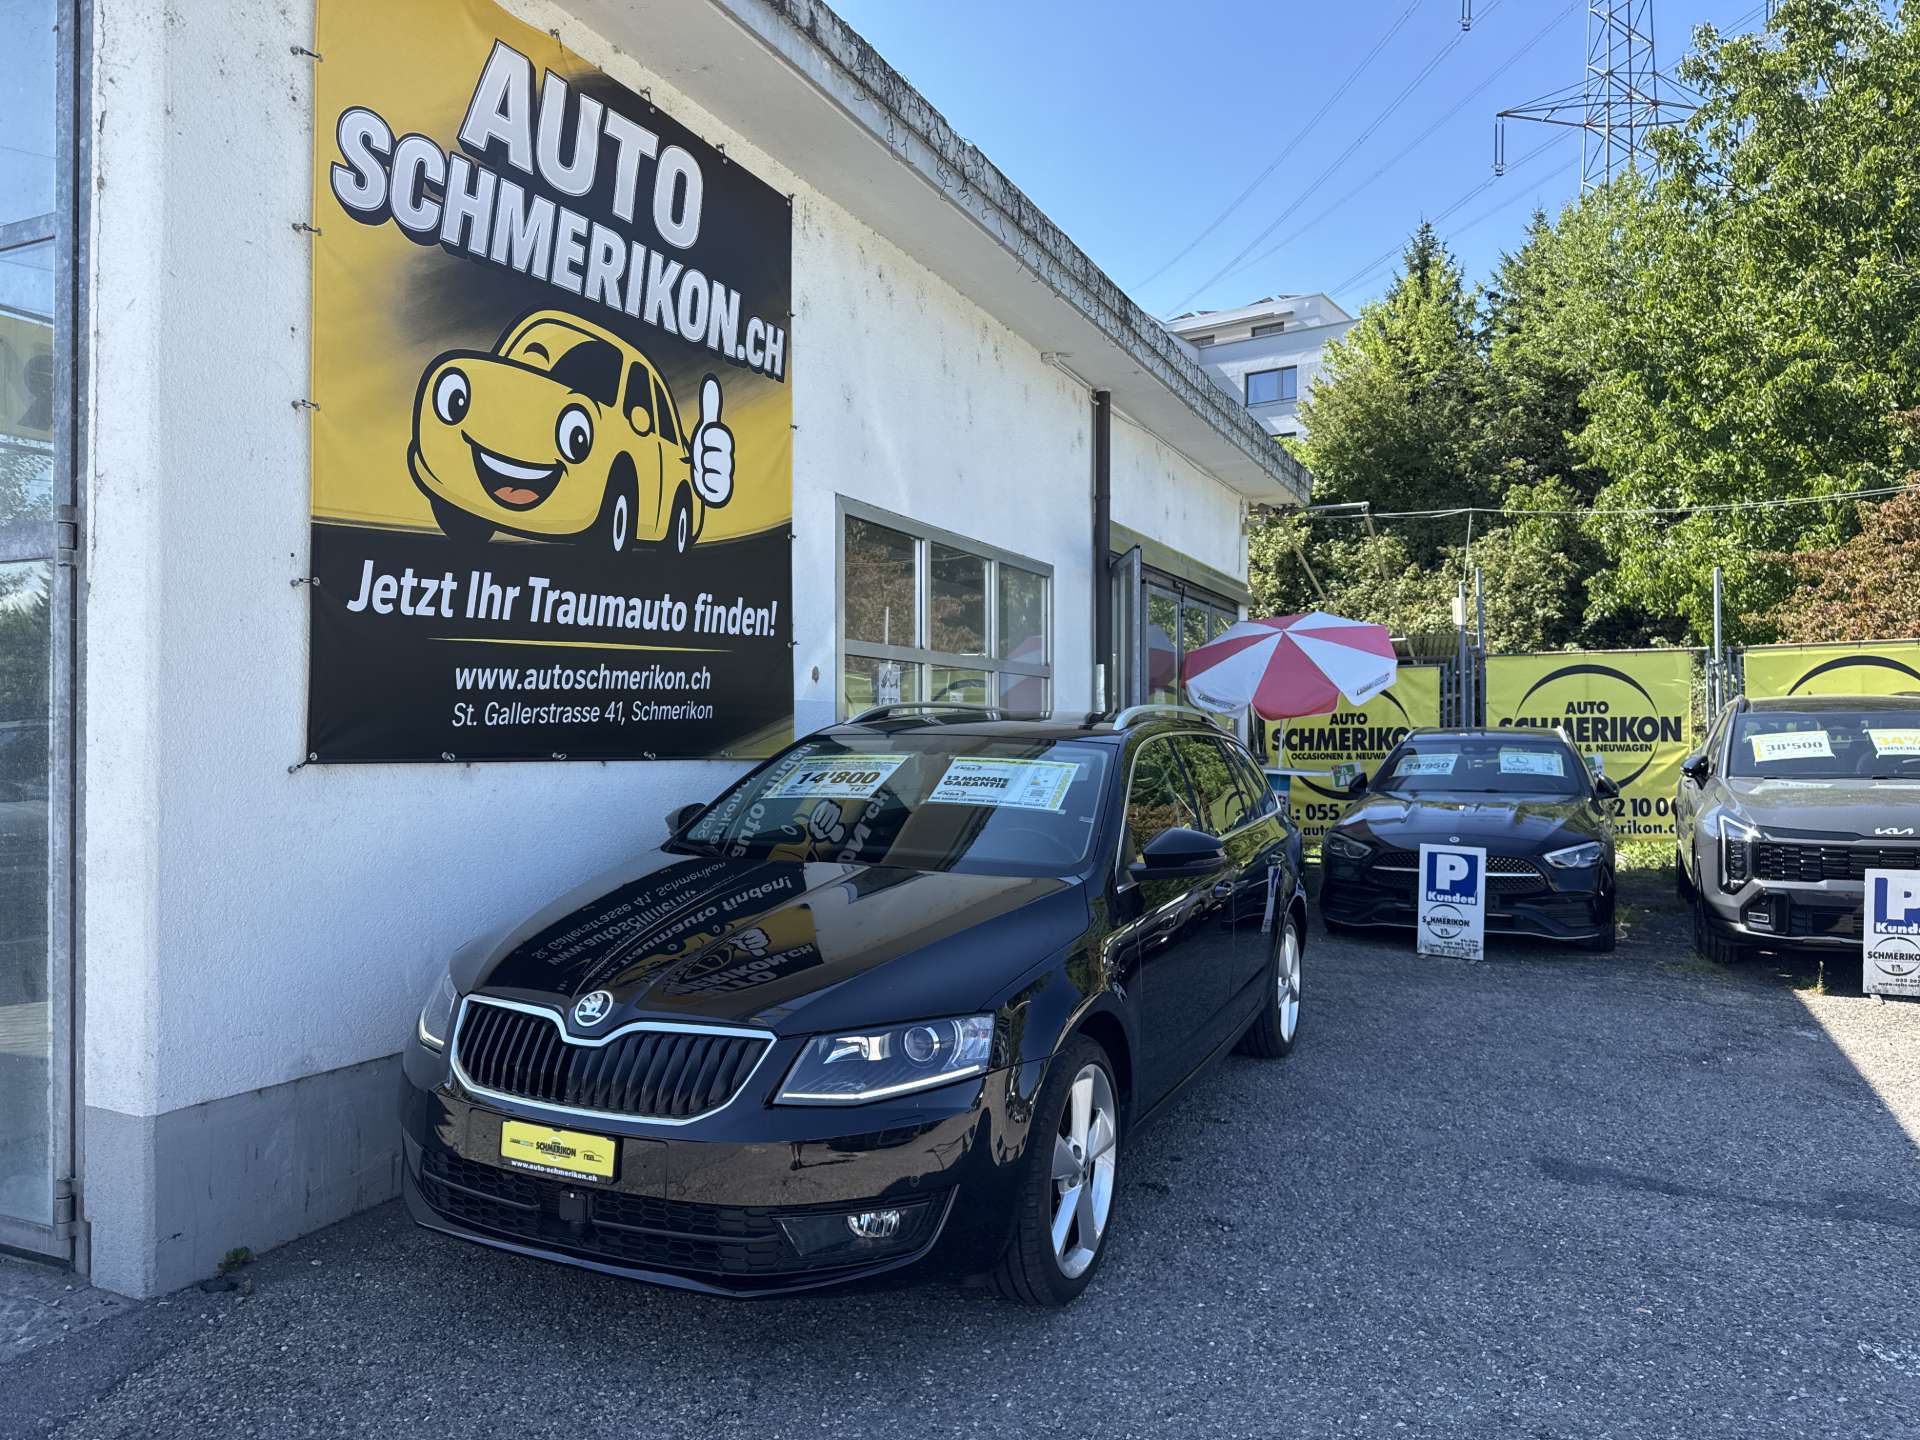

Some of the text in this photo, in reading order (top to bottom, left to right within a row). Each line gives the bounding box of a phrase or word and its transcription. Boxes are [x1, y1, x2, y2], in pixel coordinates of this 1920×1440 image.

[459, 40, 703, 249] AUTO
[332, 106, 785, 378] SCHMERIKON.CH
[346, 559, 778, 637] Jetzt Ihr Traumauto finden!
[455, 664, 711, 691] www.autoschmerikon.ch
[452, 700, 713, 727] St. Gallerstrasse 41, Schmerikon
[1565, 701, 1609, 714] AUTO
[1329, 713, 1368, 725] AUTO
[1271, 727, 1412, 752] SCHMERIKO
[1596, 743, 1653, 752] NEUWAGEN
[1291, 752, 1344, 761] OCCASIONEN
[1355, 752, 1388, 761] NEUWA
[797, 771, 881, 785] 14'800
[943, 780, 1009, 789] GARANTIE
[1305, 803, 1341, 821] 055
[1436, 853, 1469, 891] P
[1427, 891, 1478, 905] Kunden
[1867, 950, 1920, 962] SCHMERIKO
[511, 1159, 598, 1182] www.auto-schmerikon.ch
